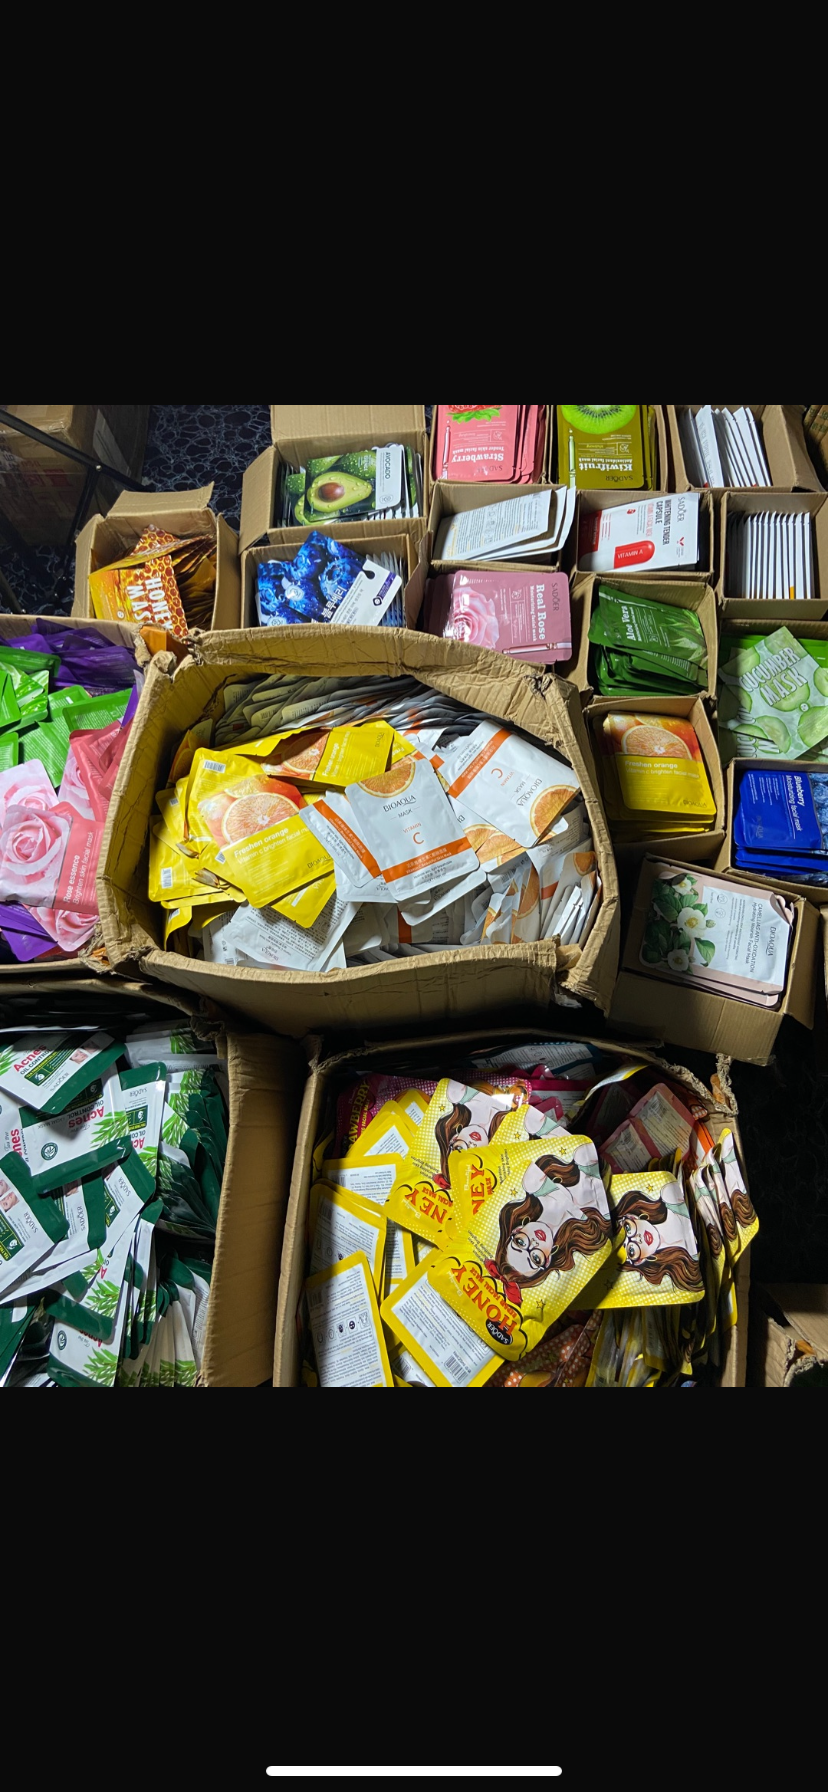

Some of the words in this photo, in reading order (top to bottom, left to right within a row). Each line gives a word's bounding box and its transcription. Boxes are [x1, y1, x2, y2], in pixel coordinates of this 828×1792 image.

[383, 451, 391, 479] AVOCADO
[451, 452, 503, 462] Strawberry
[654, 500, 663, 523] CAPSULE
[663, 499, 671, 525] WHITENING
[662, 525, 670, 545] TENDER
[617, 550, 636, 559] VITAMIN
[127, 585, 151, 623] MAS
[320, 584, 346, 619] 블루베리
[535, 584, 545, 609] Real
[620, 605, 630, 622] Vera
[537, 611, 547, 639] Rose
[625, 623, 636, 641] Aloe
[738, 647, 801, 692] CUCUMBER
[759, 667, 808, 707] MASK
[490, 767, 504, 779] C
[653, 761, 677, 769] orange
[500, 771, 515, 787] VITAMIN
[514, 781, 527, 793] MASK
[785, 774, 795, 804] Moisturizing
[518, 778, 543, 807] BIOAQUA
[793, 775, 805, 806] Blueberry
[383, 794, 416, 813] BIOAQUA
[397, 808, 412, 817] MASK
[403, 822, 422, 833] VITAMIN
[411, 831, 424, 845] C
[85, 831, 93, 847] mask
[234, 839, 262, 856] Freshen
[264, 827, 288, 842] orange
[237, 850, 258, 863] Vitamin
[263, 837, 285, 851] brighten
[286, 830, 300, 840] facial
[81, 847, 90, 863] facial
[63, 885, 72, 902] Rose
[68, 854, 80, 884] essence
[78, 863, 87, 877] skin
[72, 878, 85, 903] Brighten
[749, 901, 757, 922] Hydrating
[14, 1043, 45, 1071] Acnes
[19, 1066, 29, 1075] OIL
[29, 1047, 51, 1067] CONTROL
[66, 1104, 94, 1118] CONTROL
[67, 1107, 105, 1127] Acnes
[9, 1128, 22, 1152] nes
[421, 1186, 436, 1198] MASK
[472, 1164, 485, 1216] NEY
[486, 1177, 494, 1195] MASK
[404, 1187, 447, 1222] NEY
[470, 1267, 484, 1282] MASK
[483, 1282, 500, 1298] FACIAL
[450, 1267, 518, 1337] HONEY
